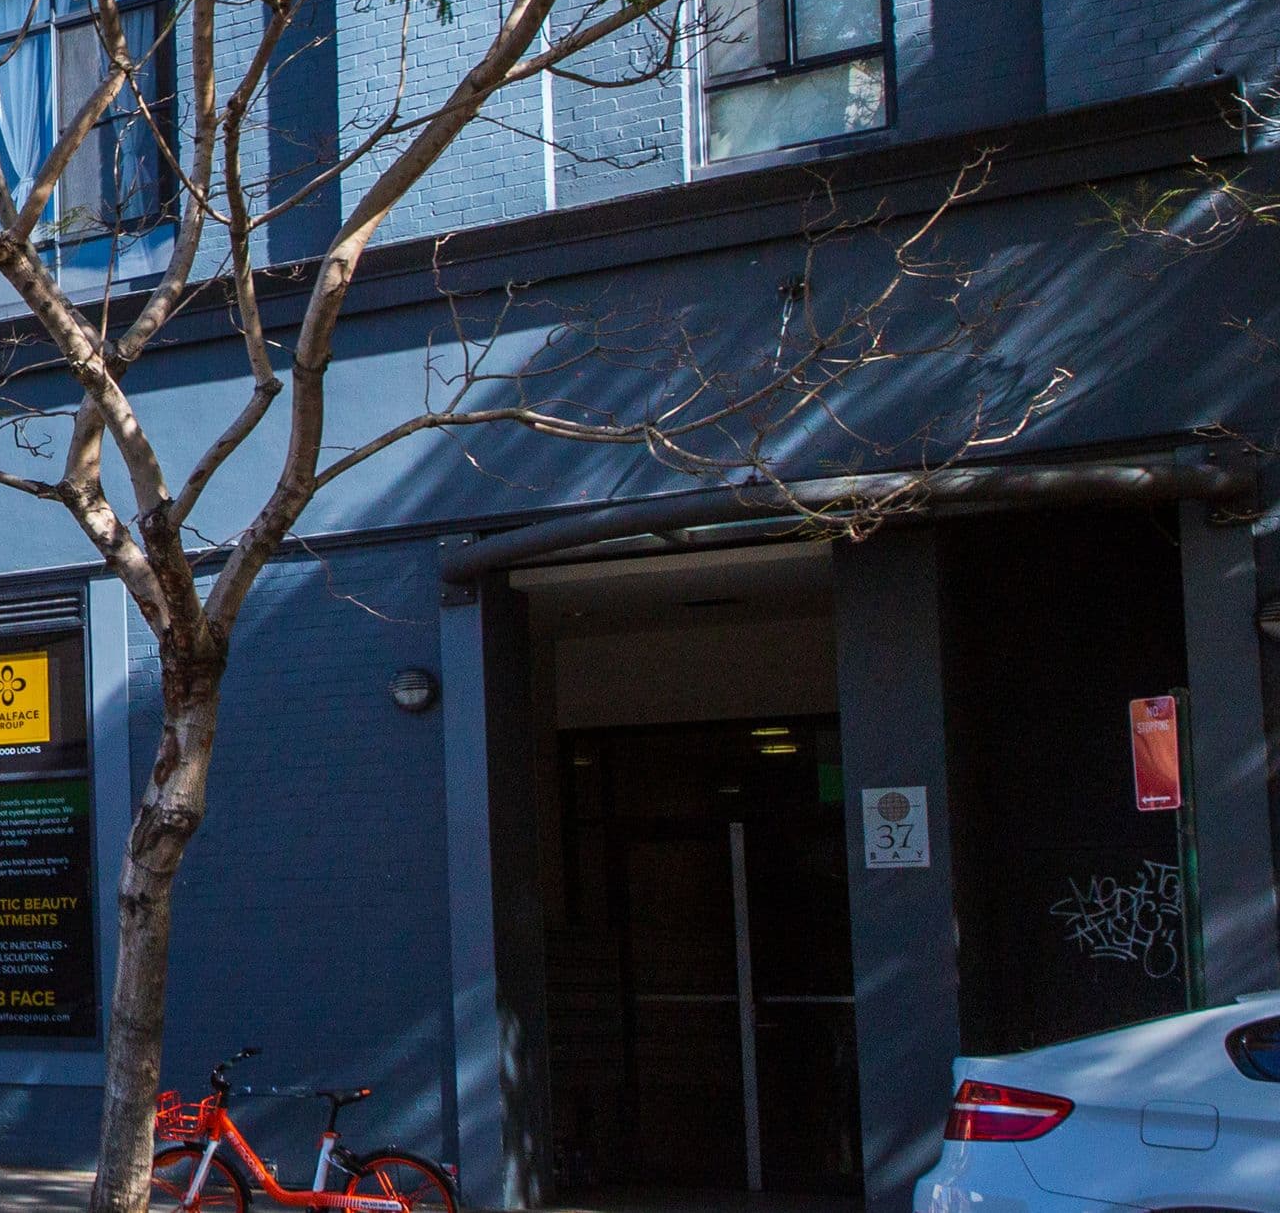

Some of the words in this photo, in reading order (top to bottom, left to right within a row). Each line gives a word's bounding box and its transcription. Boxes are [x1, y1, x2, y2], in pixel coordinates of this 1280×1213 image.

[1146, 706, 1159, 717] NO
[17, 746, 41, 755] LOOKS
[876, 824, 914, 849] 37
[24, 897, 78, 910] BEAUTY
[9, 940, 63, 950] INJECTABLES
[2, 965, 49, 974] SOLUTIONS
[10, 990, 56, 1006] FACE
